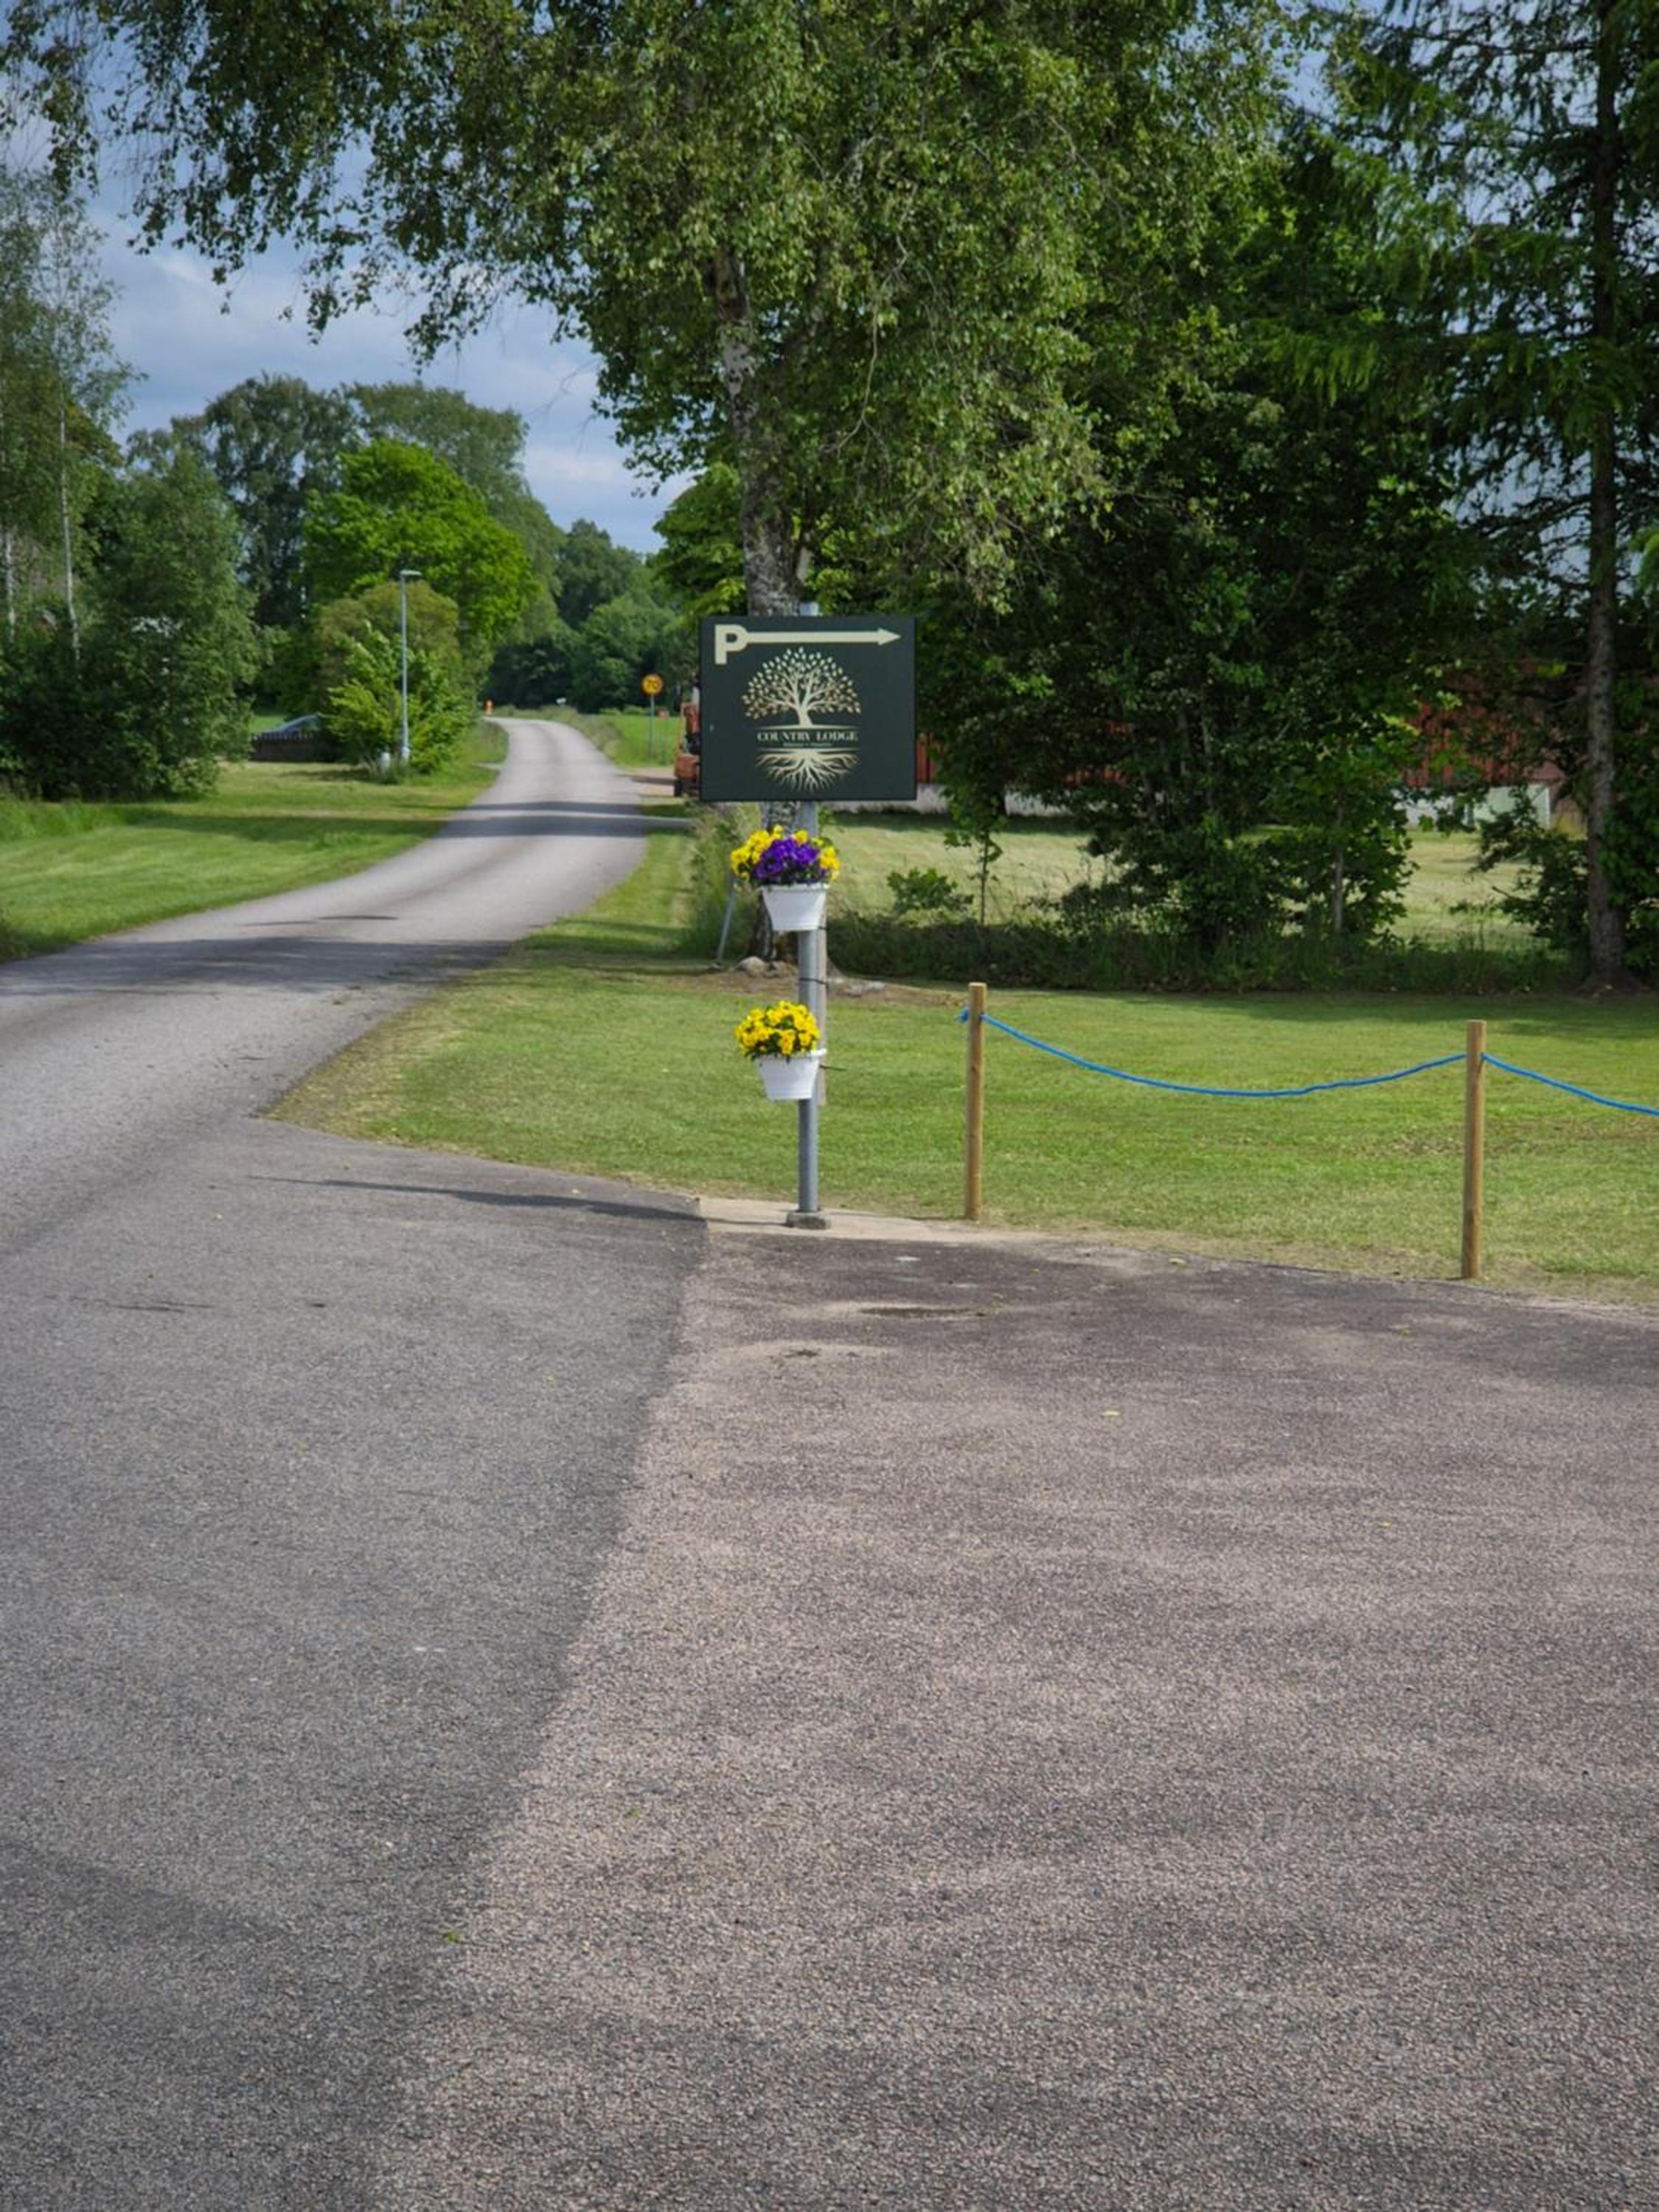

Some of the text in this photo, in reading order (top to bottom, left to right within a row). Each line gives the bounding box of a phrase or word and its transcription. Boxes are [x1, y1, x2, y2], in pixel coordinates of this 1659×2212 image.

[714, 624, 748, 665] P
[757, 731, 859, 741] COUNTRY LODGE
